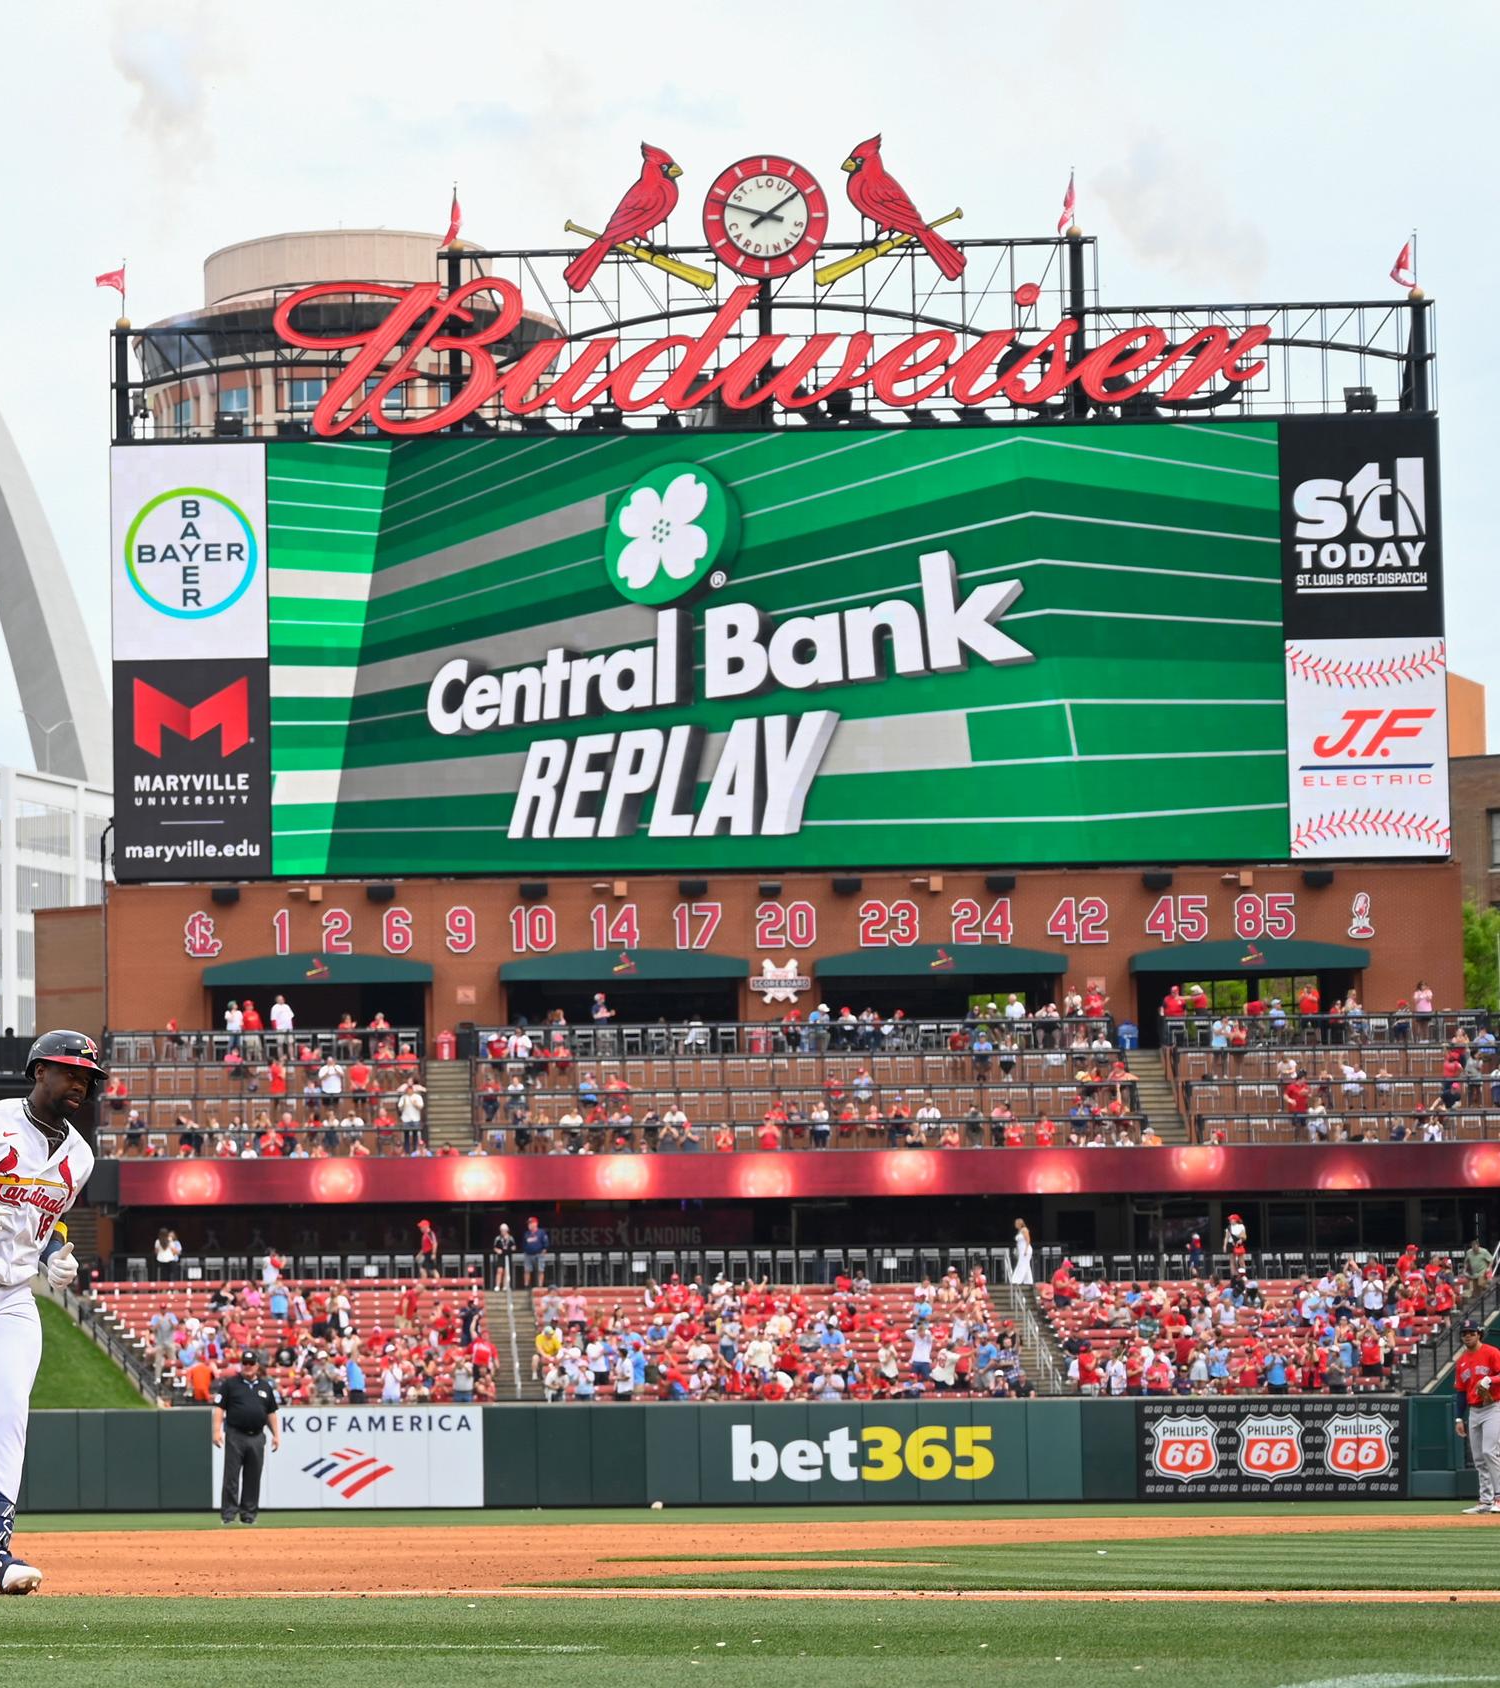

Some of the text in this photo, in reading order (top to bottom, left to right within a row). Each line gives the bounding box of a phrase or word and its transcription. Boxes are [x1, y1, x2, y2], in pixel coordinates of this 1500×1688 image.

[728, 219, 804, 256] CARDINALS
[273, 276, 1271, 437] Budweiser
[1293, 457, 1426, 540] stl
[137, 543, 245, 564] BAYER
[180, 500, 203, 607] BAYER
[1295, 542, 1426, 569] TODAY
[1296, 571, 1427, 587] ST. LOUIS POST-DISPATCH
[427, 549, 1035, 735] Central Bank
[134, 774, 249, 792] MARYVILLE
[507, 709, 840, 840] REPLAY
[1303, 774, 1433, 787] ELECTRIC
[134, 795, 249, 806] UNIVERSITY
[125, 840, 261, 863] maryville.edu
[274, 893, 1296, 955] 1 2 6 9 10 14 17 20 23 24 42 45 85
[35, 1213, 55, 1242] 18
[546, 1226, 701, 1245] REESE'S LANDING
[306, 1415, 338, 1432] OF
[347, 1414, 472, 1432] AMERICA
[1162, 1426, 1208, 1436] PHILLIPS
[1248, 1425, 1293, 1435] PHILLIPS
[1335, 1424, 1382, 1435] PHILLIPS
[731, 1425, 995, 1482] bet365
[1165, 1442, 1205, 1466] 66
[1251, 1442, 1291, 1466] 66
[1337, 1441, 1378, 1465] 66
